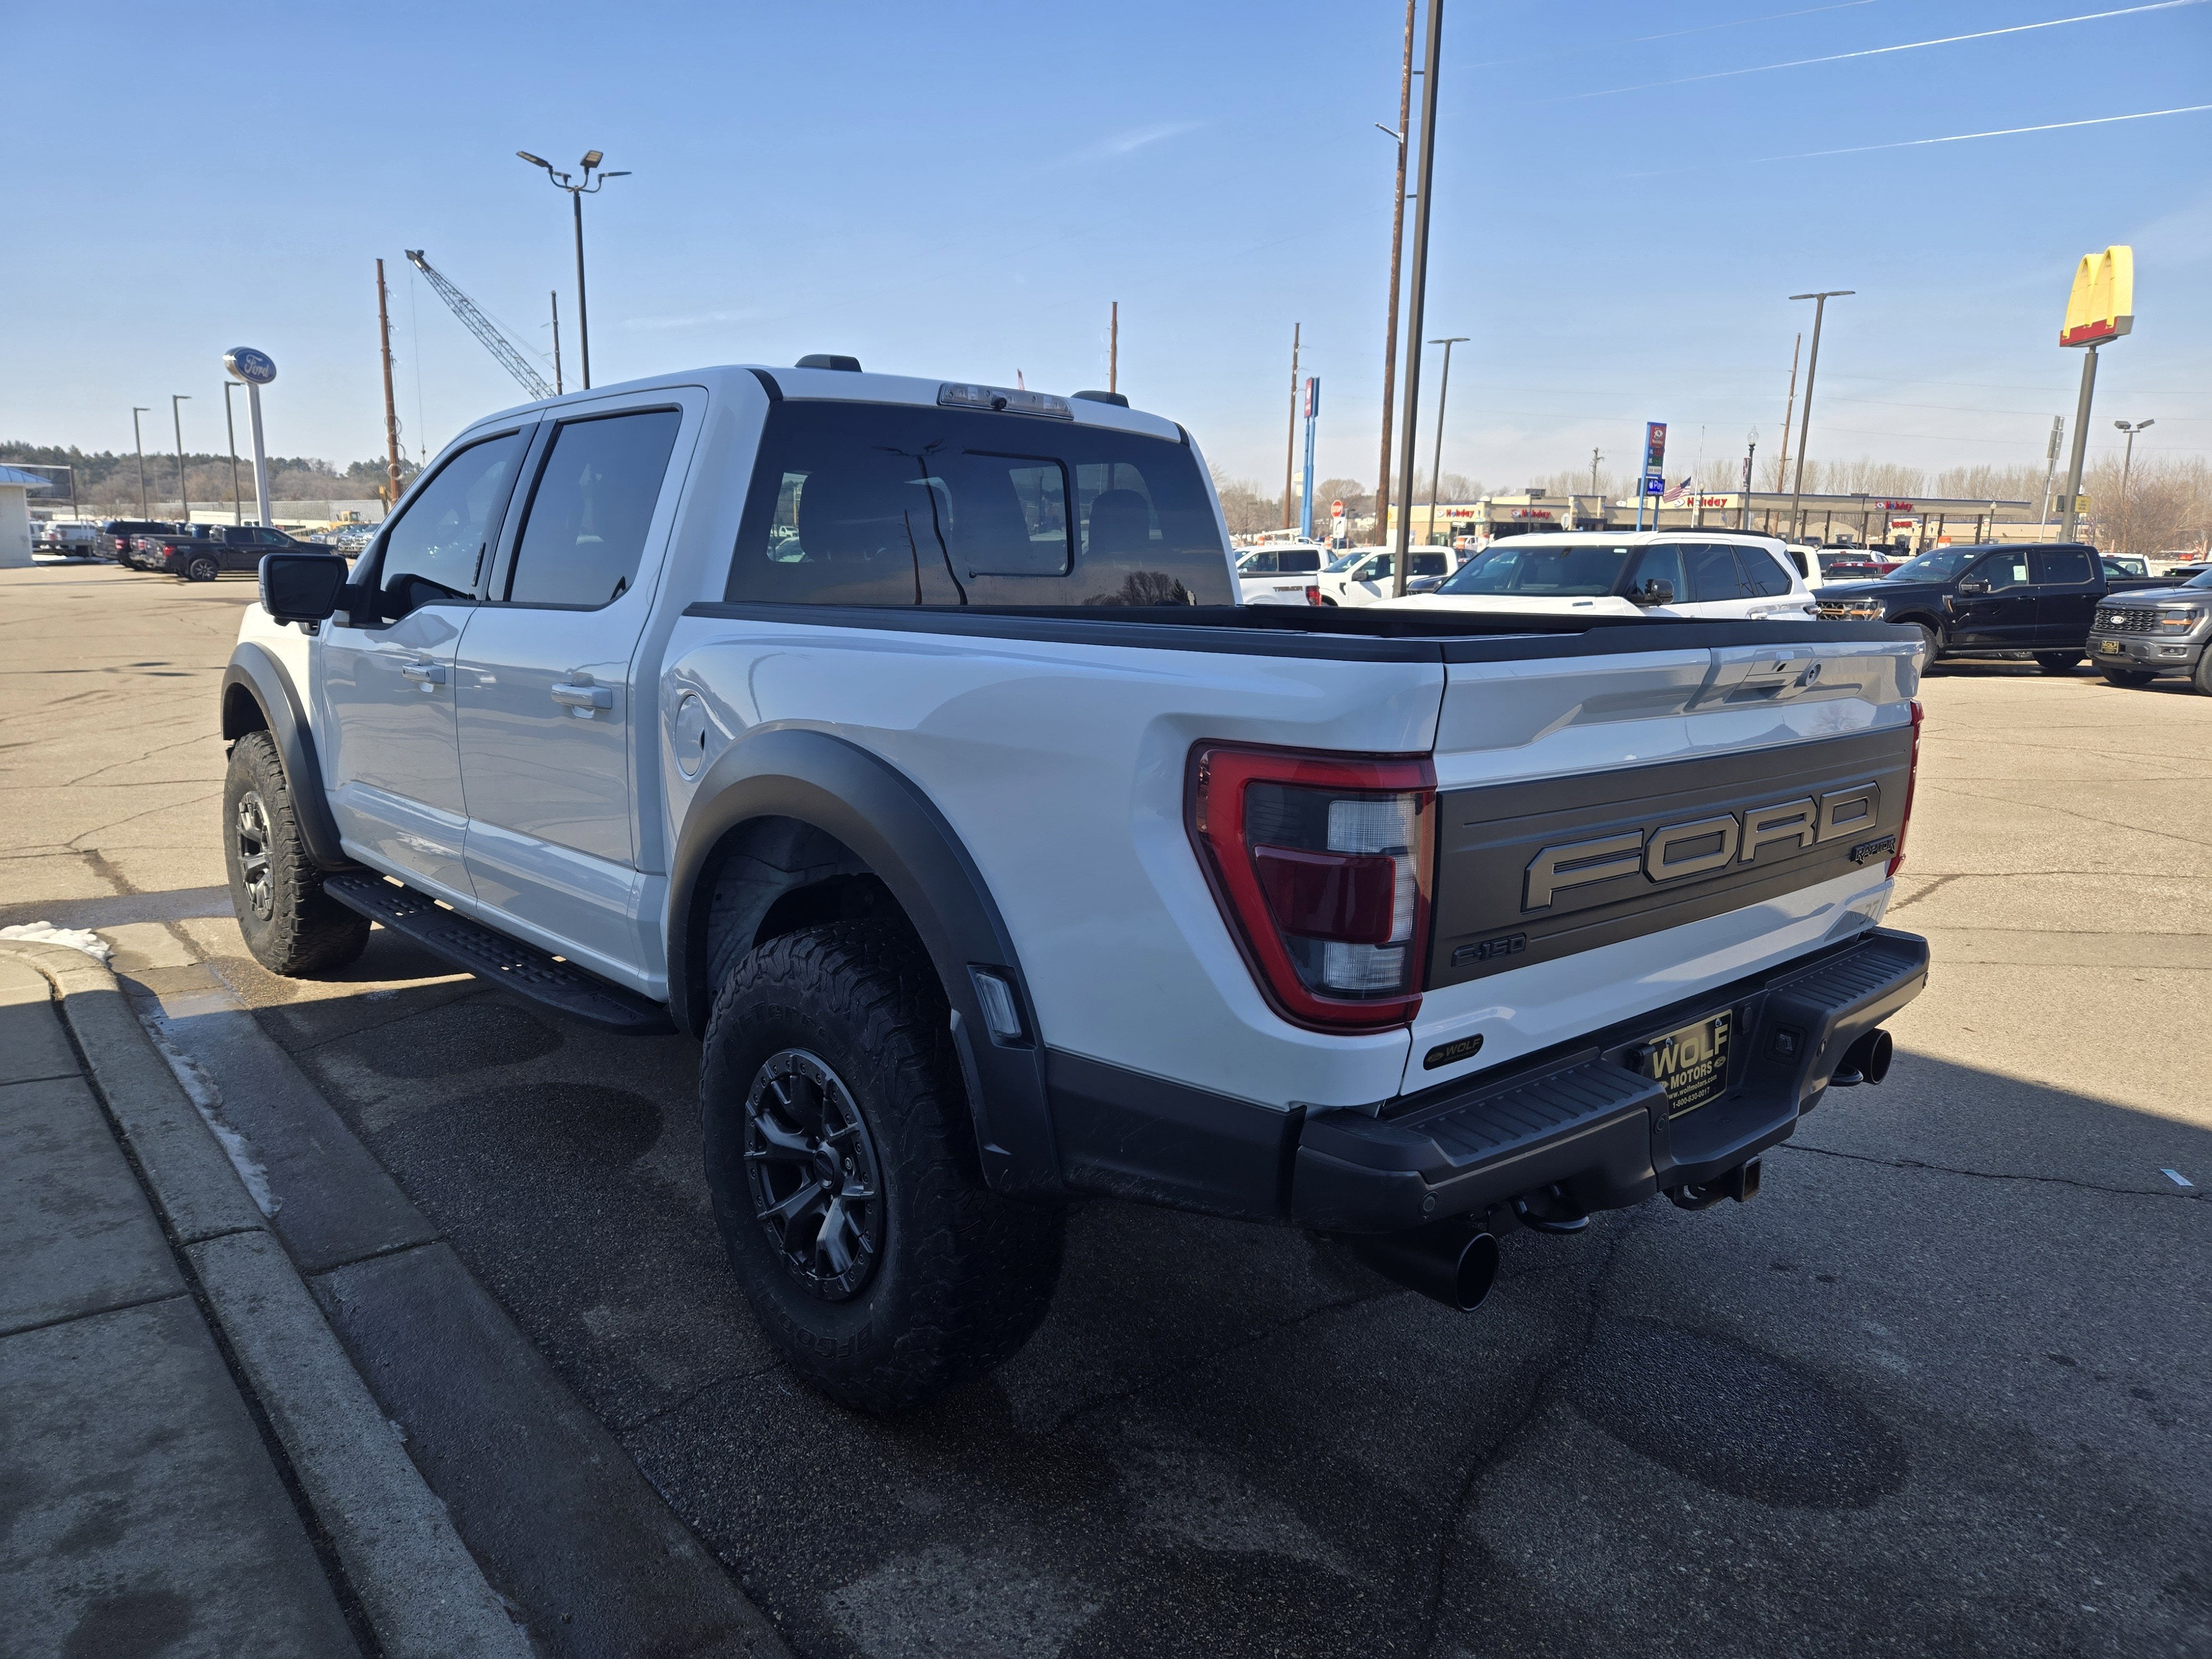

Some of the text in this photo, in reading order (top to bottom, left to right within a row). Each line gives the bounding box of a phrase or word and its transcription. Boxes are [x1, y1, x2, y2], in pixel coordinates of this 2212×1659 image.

[244, 354, 269, 377] Ford
[1446, 509, 1475, 519] Holiday
[1687, 497, 1728, 508] Hliday
[1521, 781, 1880, 912] FORD
[1852, 836, 1896, 864] RAPTOR
[1452, 933, 1527, 967] F-150
[1446, 1038, 1481, 1056] WOLF
[1652, 1024, 1728, 1079] WOLF
[1671, 1061, 1713, 1089] MOTORS
[1672, 1086, 1710, 1109] 1-800-830-0017
